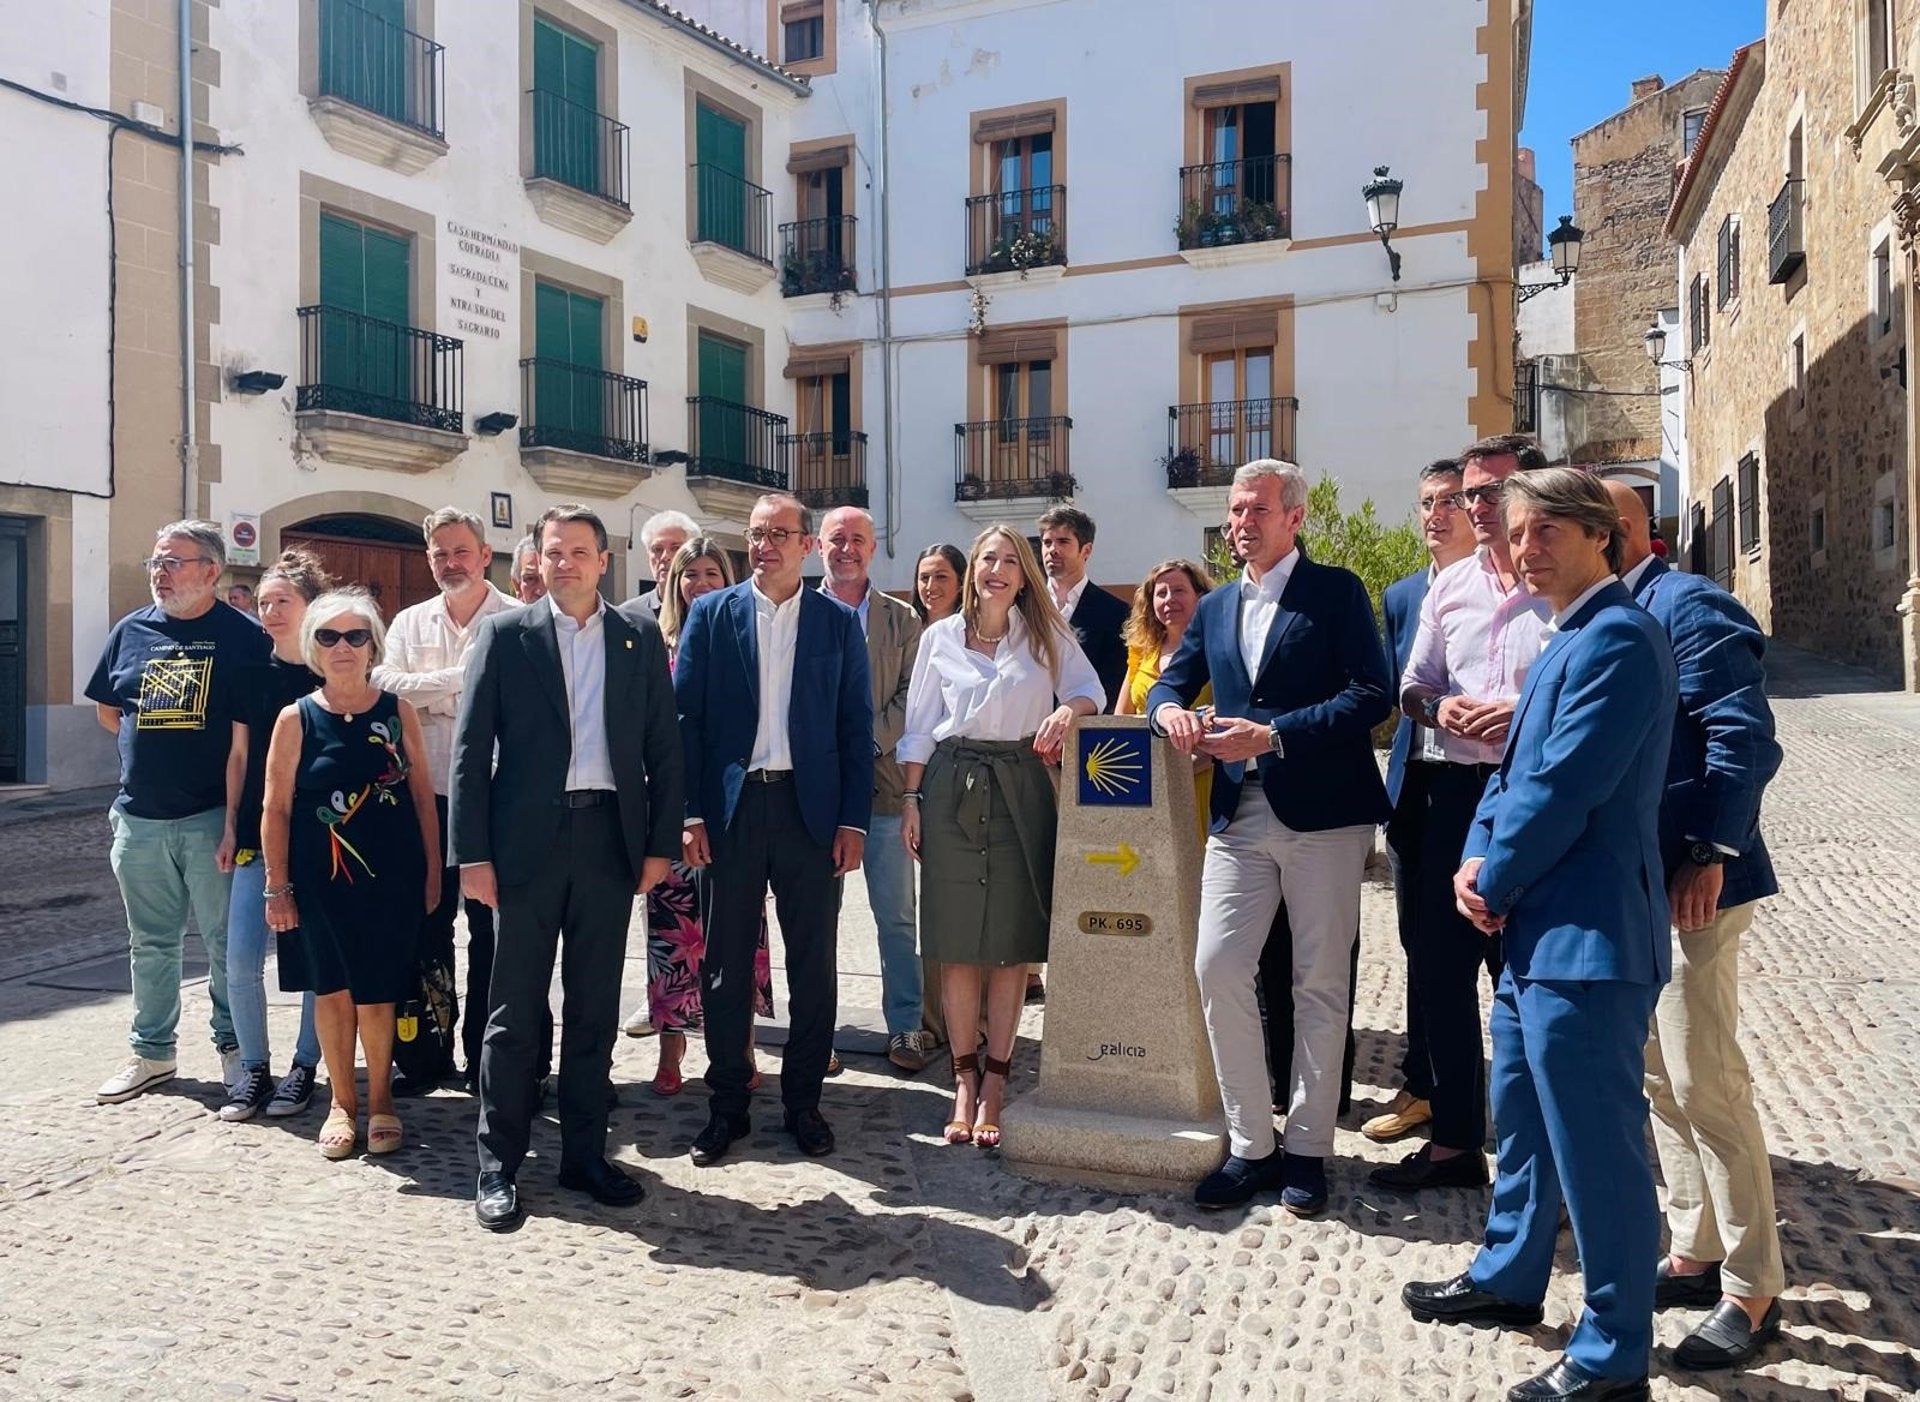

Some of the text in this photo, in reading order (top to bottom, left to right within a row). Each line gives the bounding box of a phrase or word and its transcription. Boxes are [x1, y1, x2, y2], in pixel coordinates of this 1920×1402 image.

[450, 264, 509, 292] SAGRADA CENA
[475, 287, 481, 298] Y
[490, 308, 507, 323] DEL
[458, 319, 500, 340] SAGRARIO
[1089, 917, 1143, 931] PK. 695
[1086, 1041, 1146, 1060] galicia
